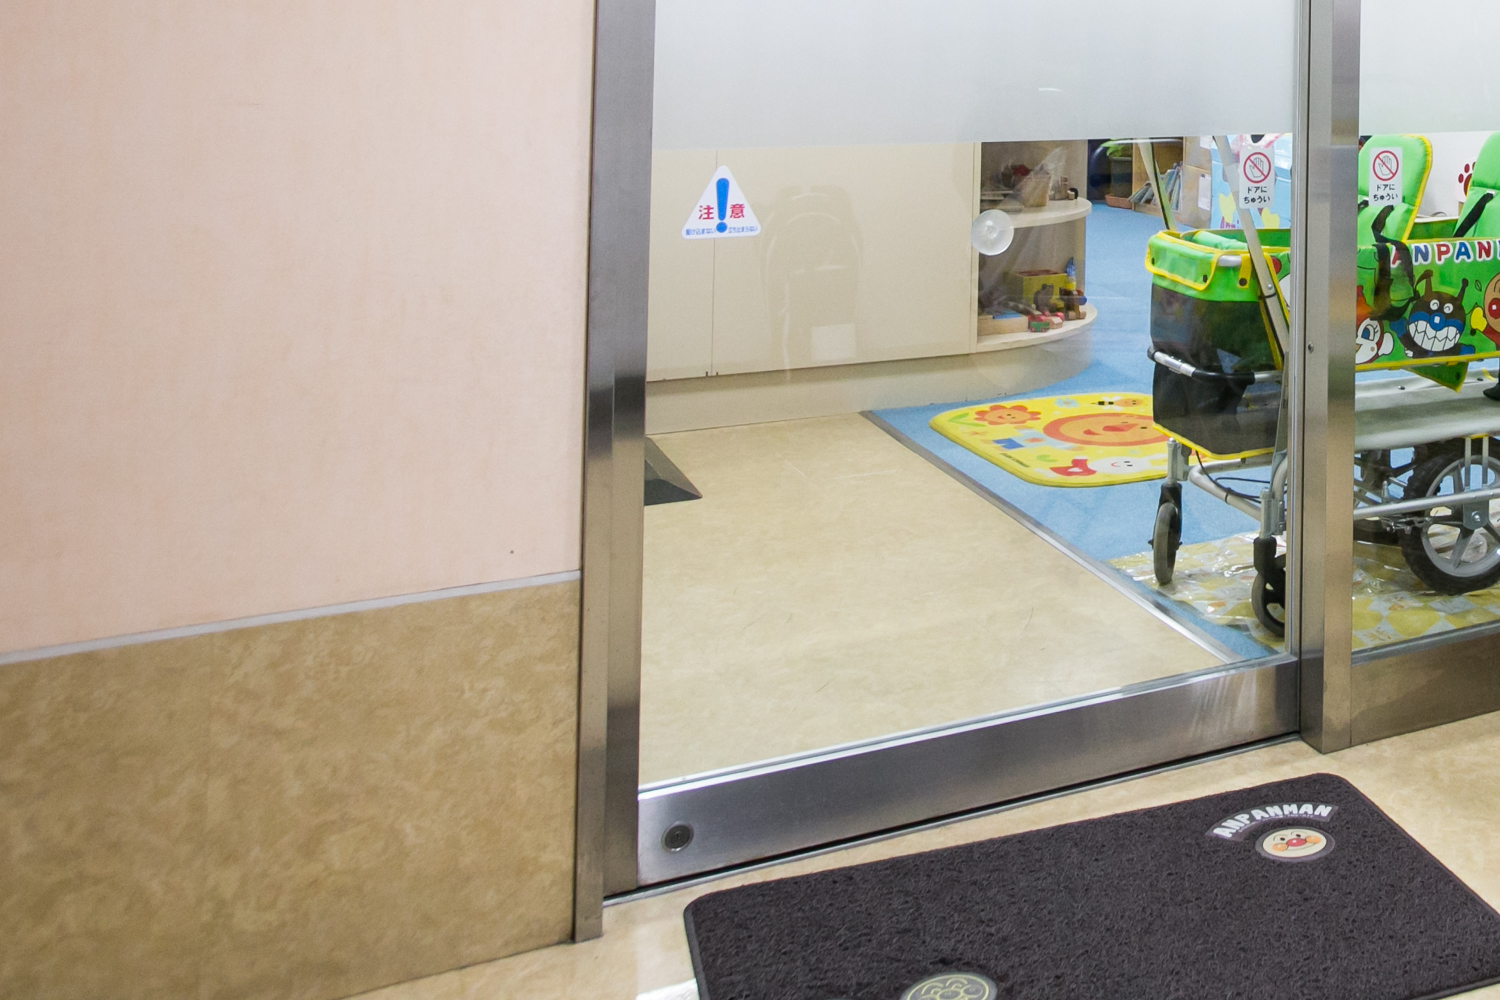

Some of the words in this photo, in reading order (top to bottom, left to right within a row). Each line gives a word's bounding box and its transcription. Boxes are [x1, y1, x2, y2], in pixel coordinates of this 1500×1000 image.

[1247, 185, 1268, 194] ドアに
[1376, 183, 1396, 192] ドアに
[1243, 195, 1271, 205] ちゅうい
[1373, 193, 1399, 202] ちゅうい
[1213, 803, 1332, 838] ANPANMAN
